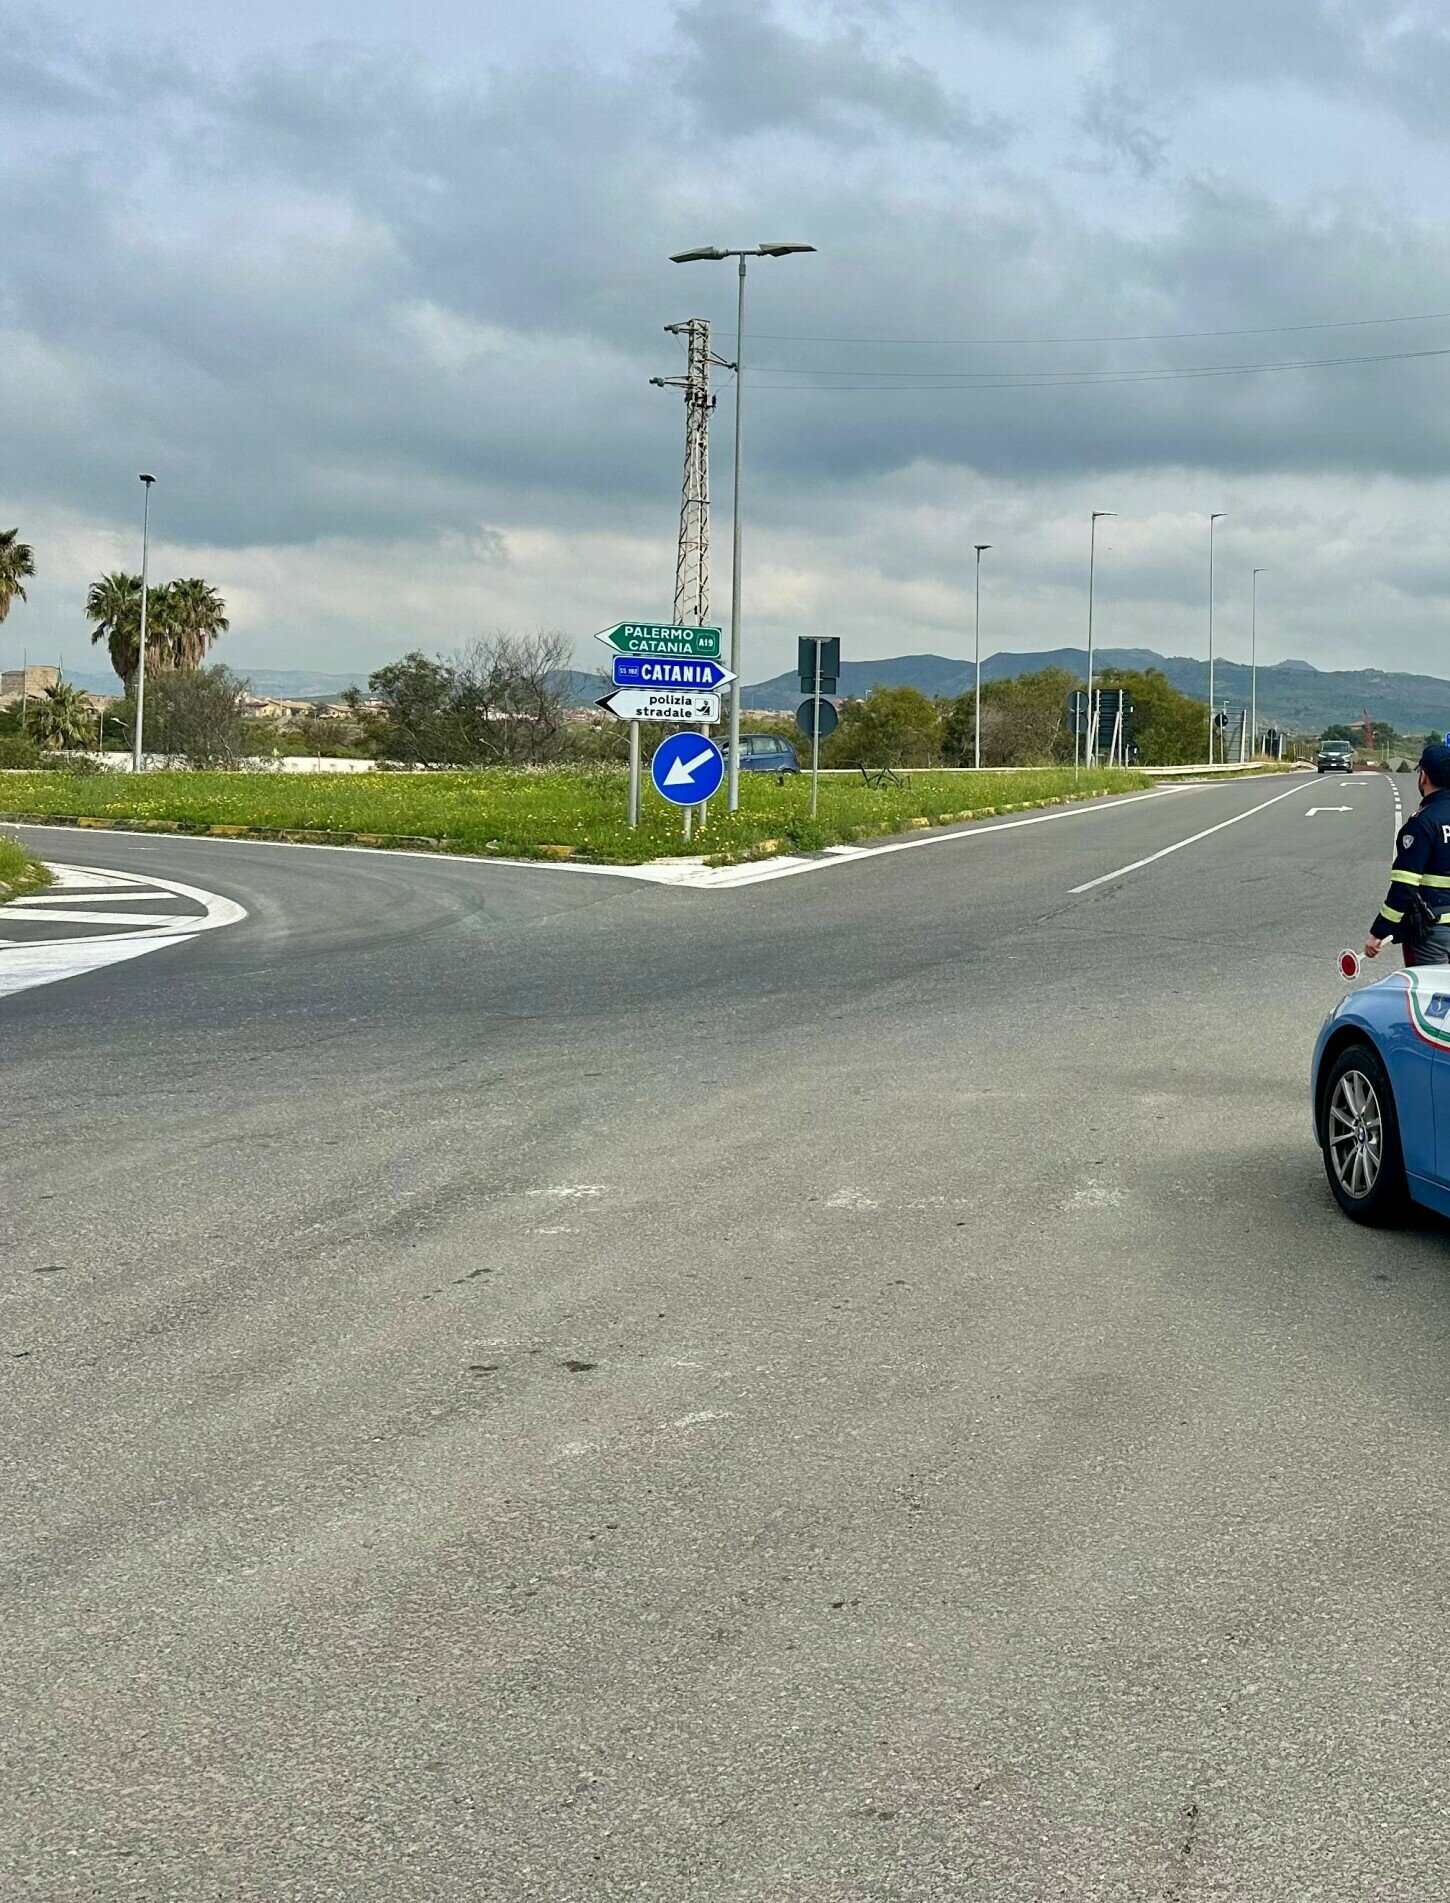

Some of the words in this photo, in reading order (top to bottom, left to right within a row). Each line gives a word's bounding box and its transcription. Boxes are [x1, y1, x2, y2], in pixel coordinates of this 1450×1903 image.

[624, 626, 694, 640] PALERMO
[628, 640, 693, 653] CATANIA
[698, 639, 714, 647] A19
[641, 664, 713, 683] CATANIA
[649, 695, 692, 706] polizia
[636, 706, 692, 718] stradale
